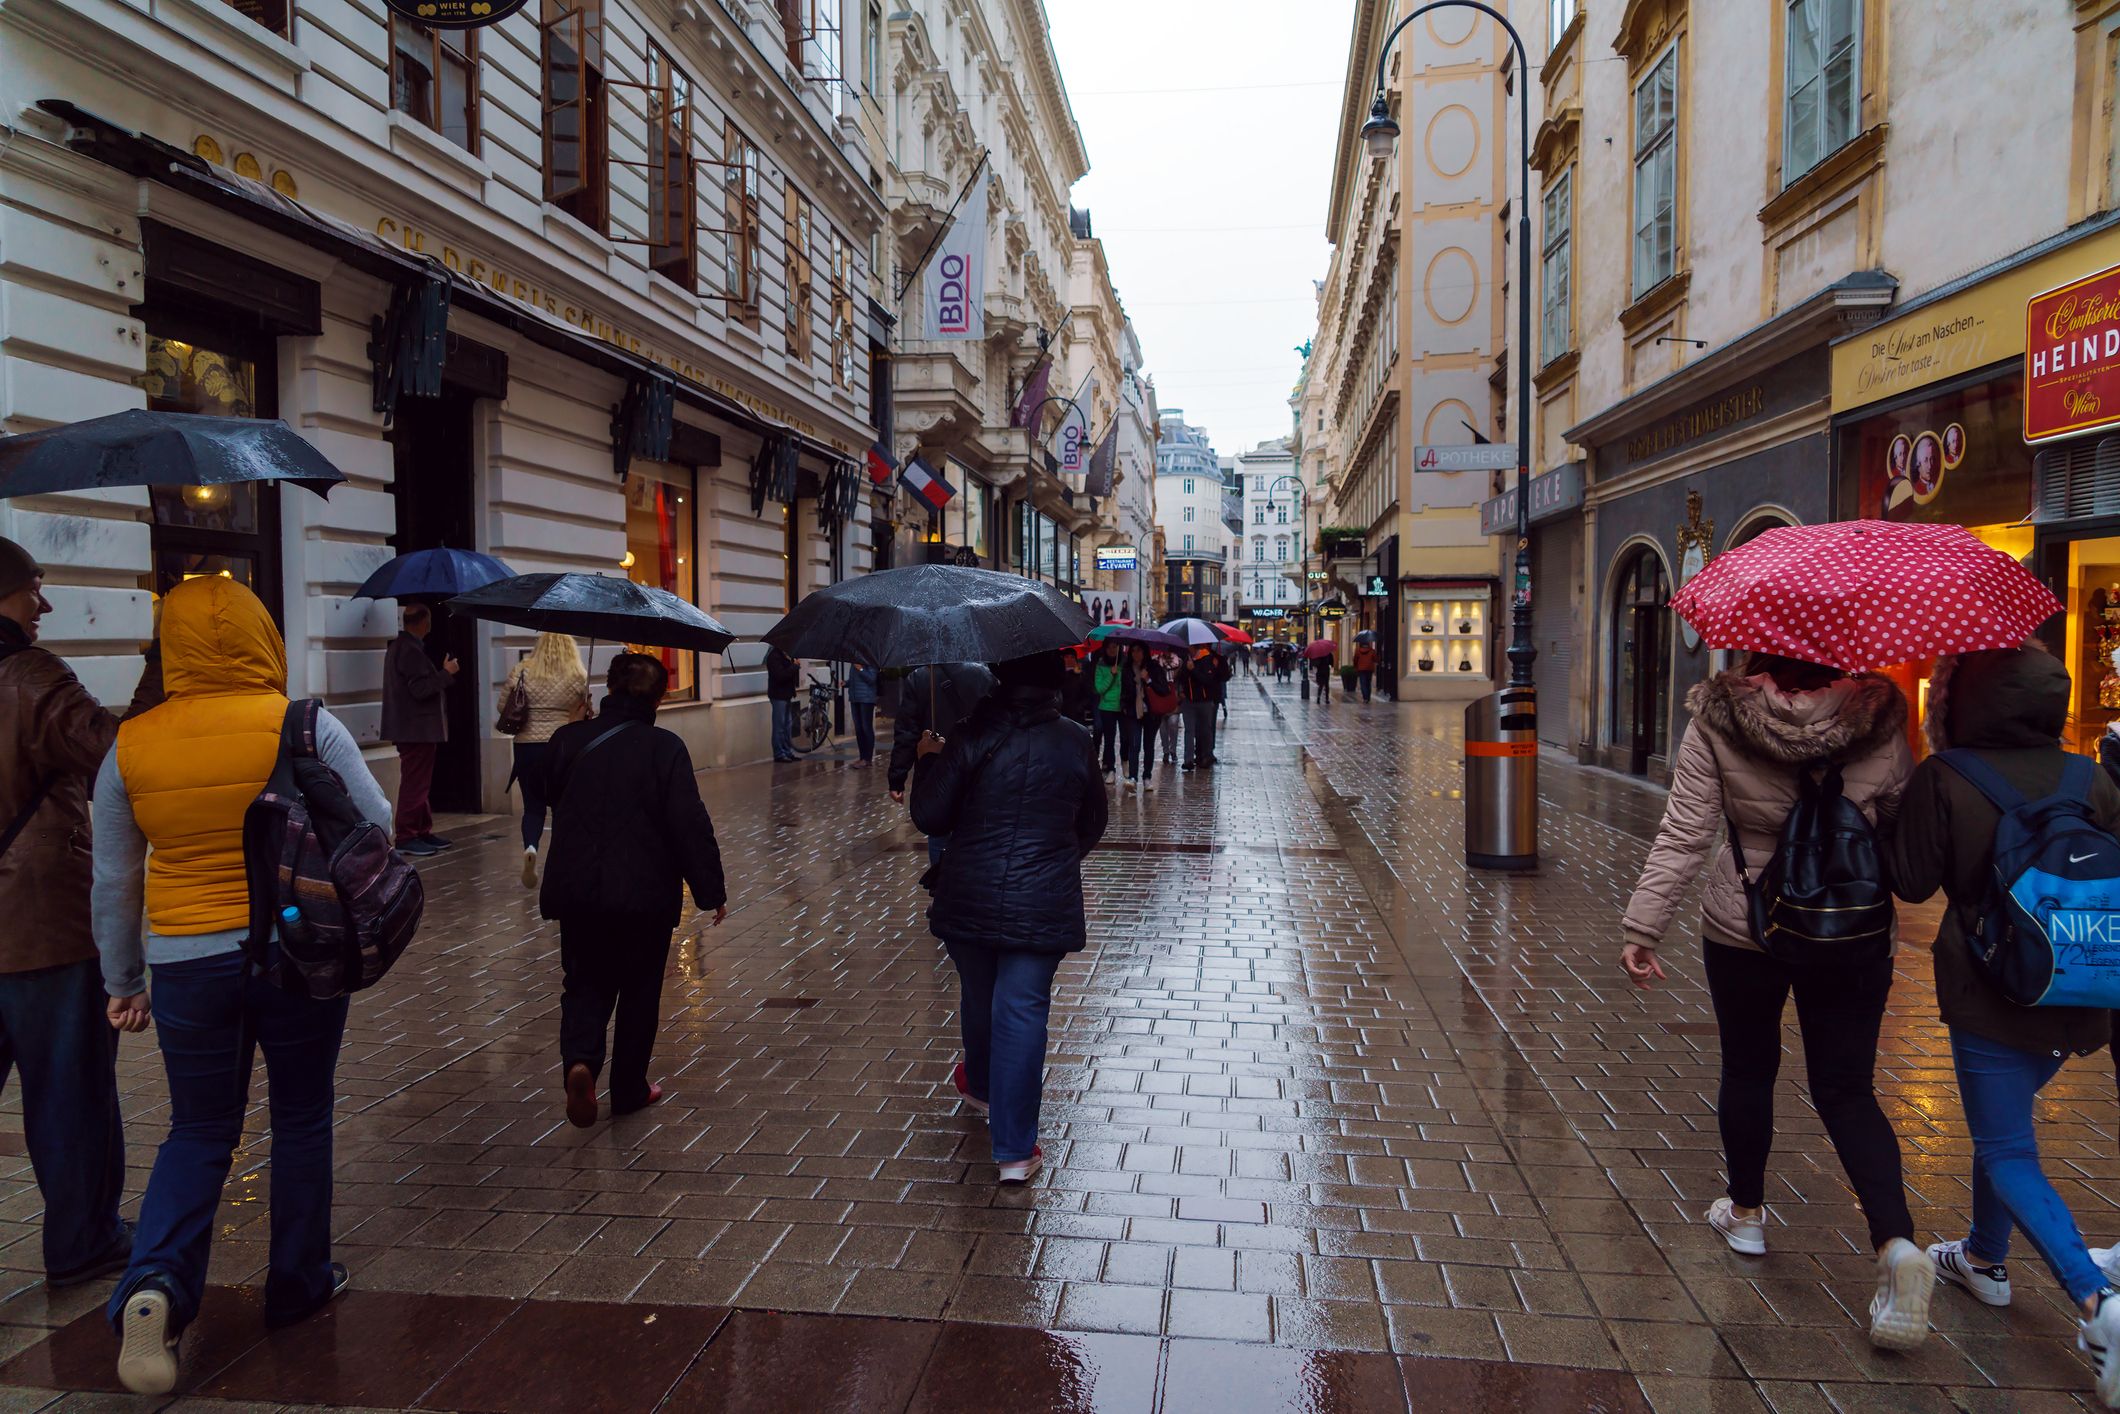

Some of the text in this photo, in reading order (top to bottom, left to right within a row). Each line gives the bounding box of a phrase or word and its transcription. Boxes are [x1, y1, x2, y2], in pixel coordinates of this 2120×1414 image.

[940, 254, 964, 324] BDO
[2045, 295, 2120, 340] Confiserie
[1871, 343, 1885, 359] Die
[1916, 331, 1931, 348] am
[1932, 315, 1974, 342] Naschen
[1898, 359, 1910, 377] for
[1911, 354, 1933, 373] taste
[2063, 389, 2101, 419] Wien
[1063, 425, 1079, 465] BDO
[1420, 449, 1513, 468] APOTHEKE
[1492, 473, 1562, 527] APOEKE
[1253, 608, 1284, 617] WAGNER
[2051, 913, 2120, 943] NIKE
